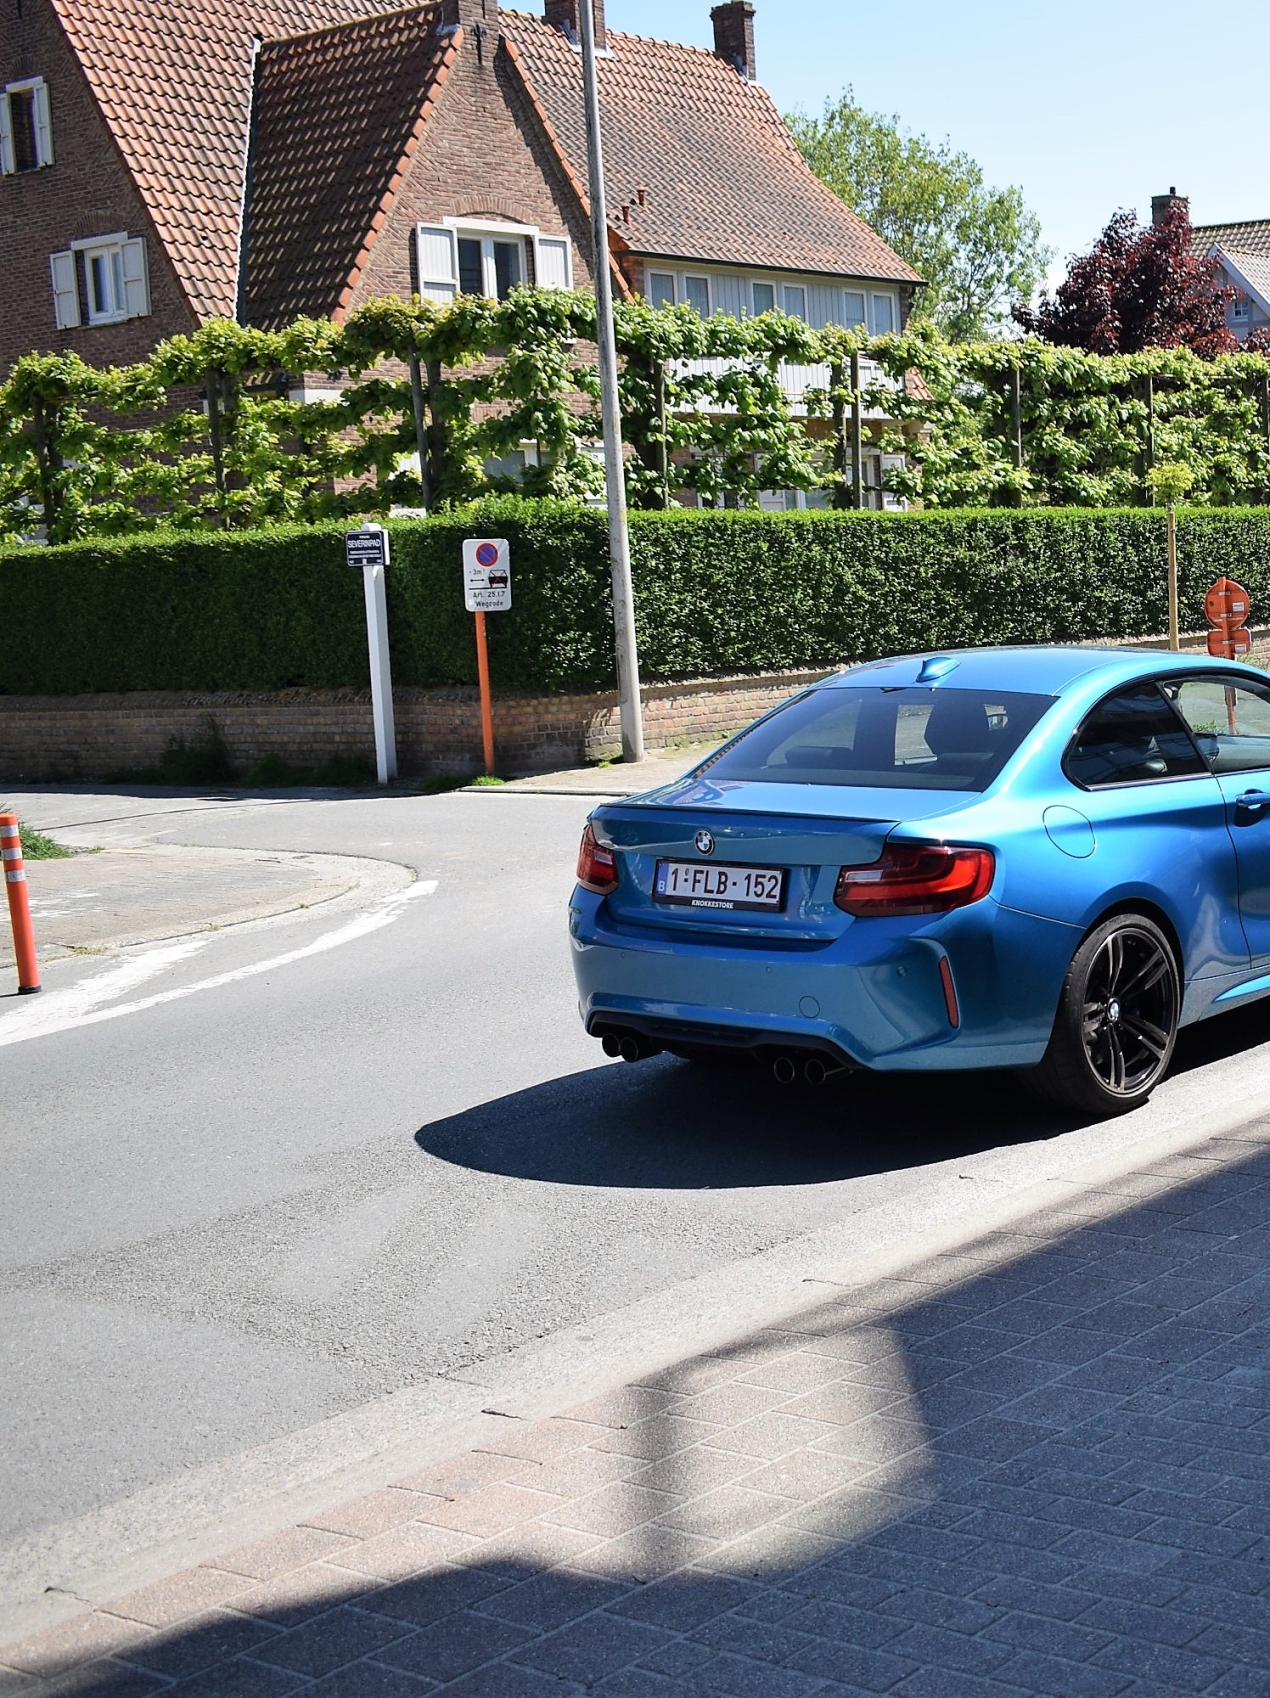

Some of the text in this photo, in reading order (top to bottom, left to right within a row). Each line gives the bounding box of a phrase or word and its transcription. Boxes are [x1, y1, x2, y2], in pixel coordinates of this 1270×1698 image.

[347, 539, 381, 548] SEVERINPAD
[475, 600, 504, 608] Wegcode
[658, 867, 779, 899] B 1-FLB-152
[691, 899, 734, 909] KNOKKESTORE
